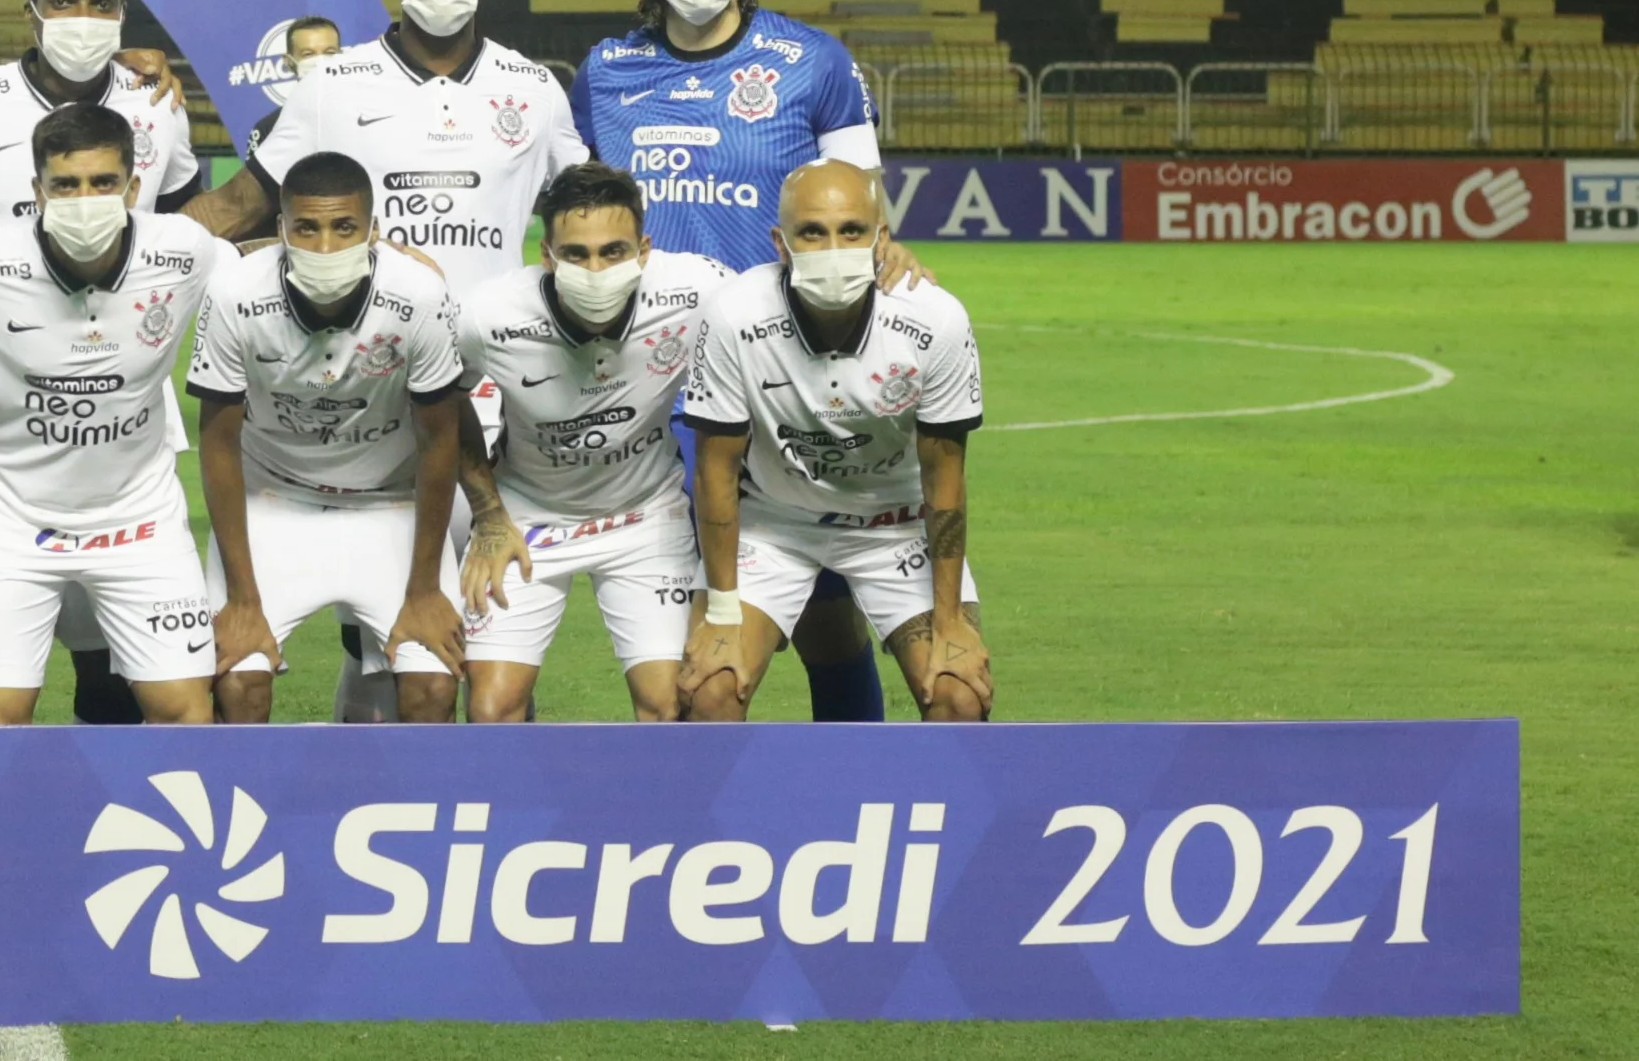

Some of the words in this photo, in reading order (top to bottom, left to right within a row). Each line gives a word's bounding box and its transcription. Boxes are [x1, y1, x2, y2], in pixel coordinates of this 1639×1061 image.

[615, 45, 657, 57] bmg
[763, 39, 803, 64] bmg
[339, 63, 384, 76] bmg
[508, 62, 549, 83] bmg
[669, 90, 715, 101] hapvida
[427, 131, 474, 142] hapvida
[638, 127, 713, 142] vitaminas
[631, 147, 691, 172] neo
[390, 173, 475, 187] vitaminas
[1158, 161, 1292, 187] Consórcio
[385, 193, 454, 218] neo
[1158, 191, 1442, 240] Embracon
[154, 250, 194, 274] bmg
[252, 297, 292, 318] bmg
[373, 290, 414, 322] bmg
[655, 290, 699, 309] bmg
[504, 318, 553, 338] bmg
[753, 319, 795, 340] bmg
[891, 314, 934, 351] bmg
[70, 341, 119, 354] hapvida
[580, 380, 628, 396] hapvida
[25, 391, 96, 419] neo
[814, 409, 862, 419] hapvida
[27, 408, 149, 446] química
[570, 510, 645, 539] ALE
[81, 520, 157, 551] ALE
[152, 597, 198, 613] Cartão
[322, 802, 944, 946] Sicredi
[1019, 801, 1441, 946] 2021
